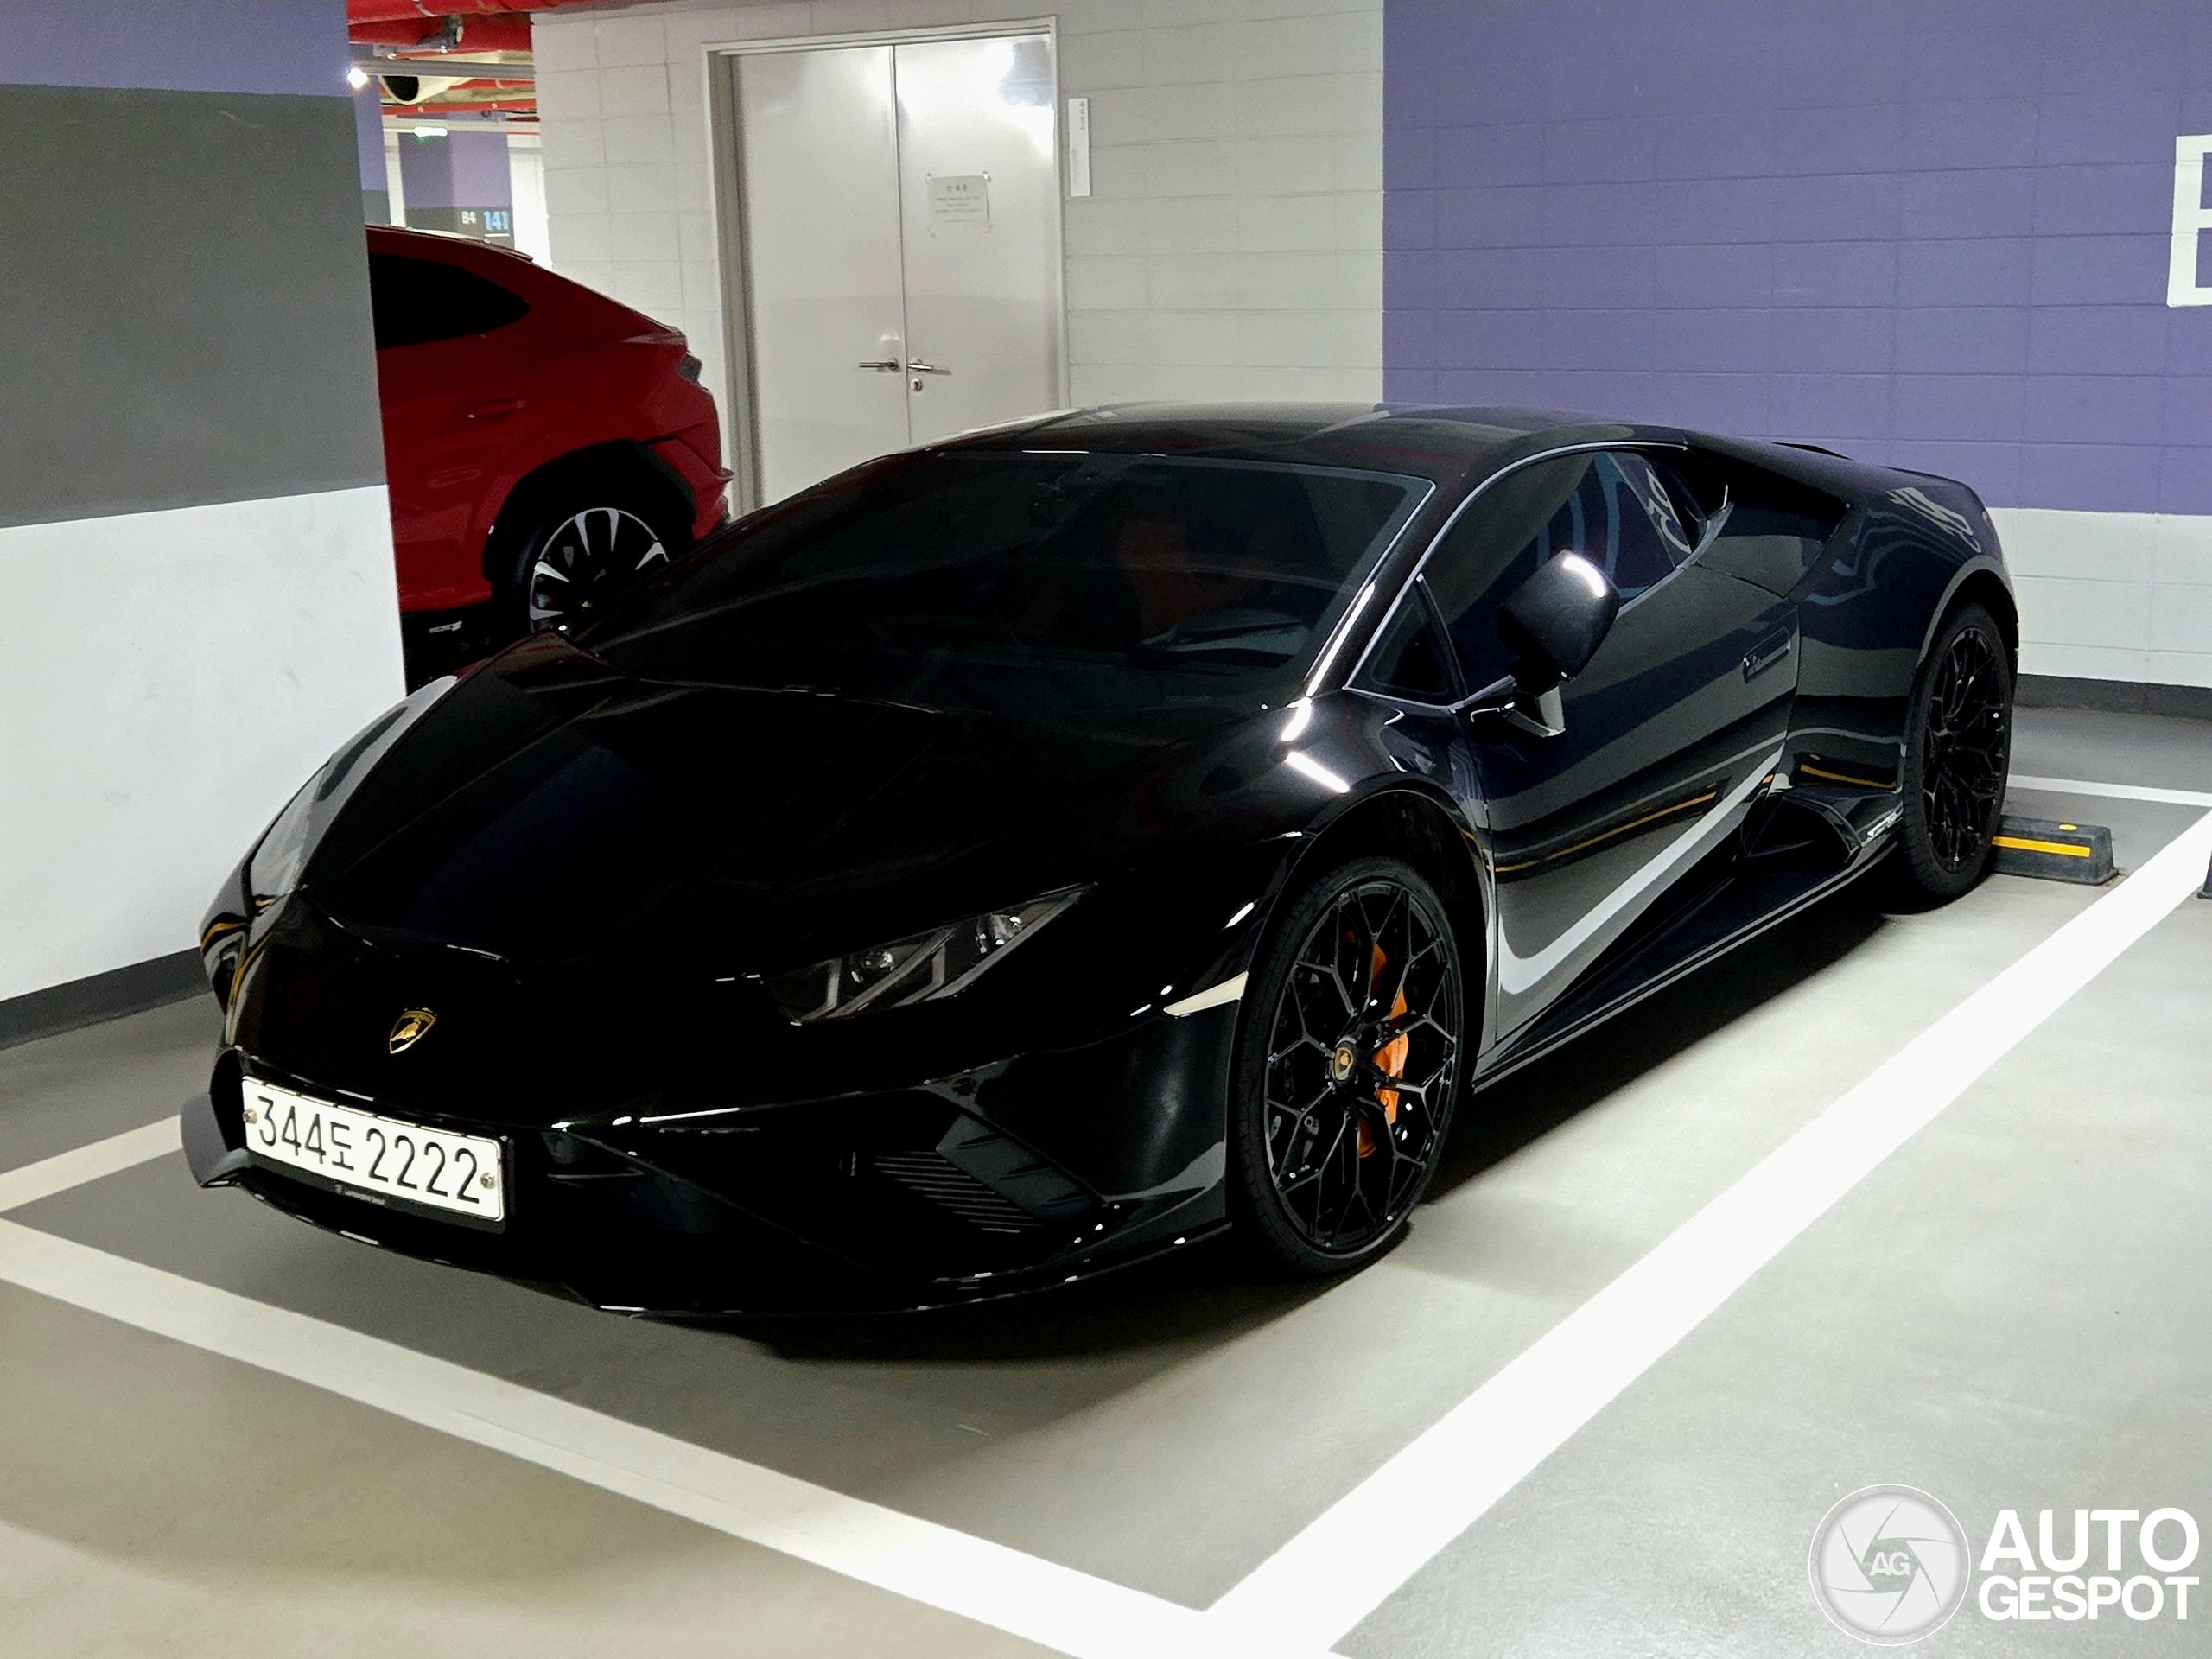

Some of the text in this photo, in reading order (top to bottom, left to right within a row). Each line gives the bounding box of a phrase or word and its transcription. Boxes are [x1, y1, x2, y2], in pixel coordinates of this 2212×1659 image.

[484, 211, 509, 230] 141
[257, 1095, 480, 1205] 344도 2222
